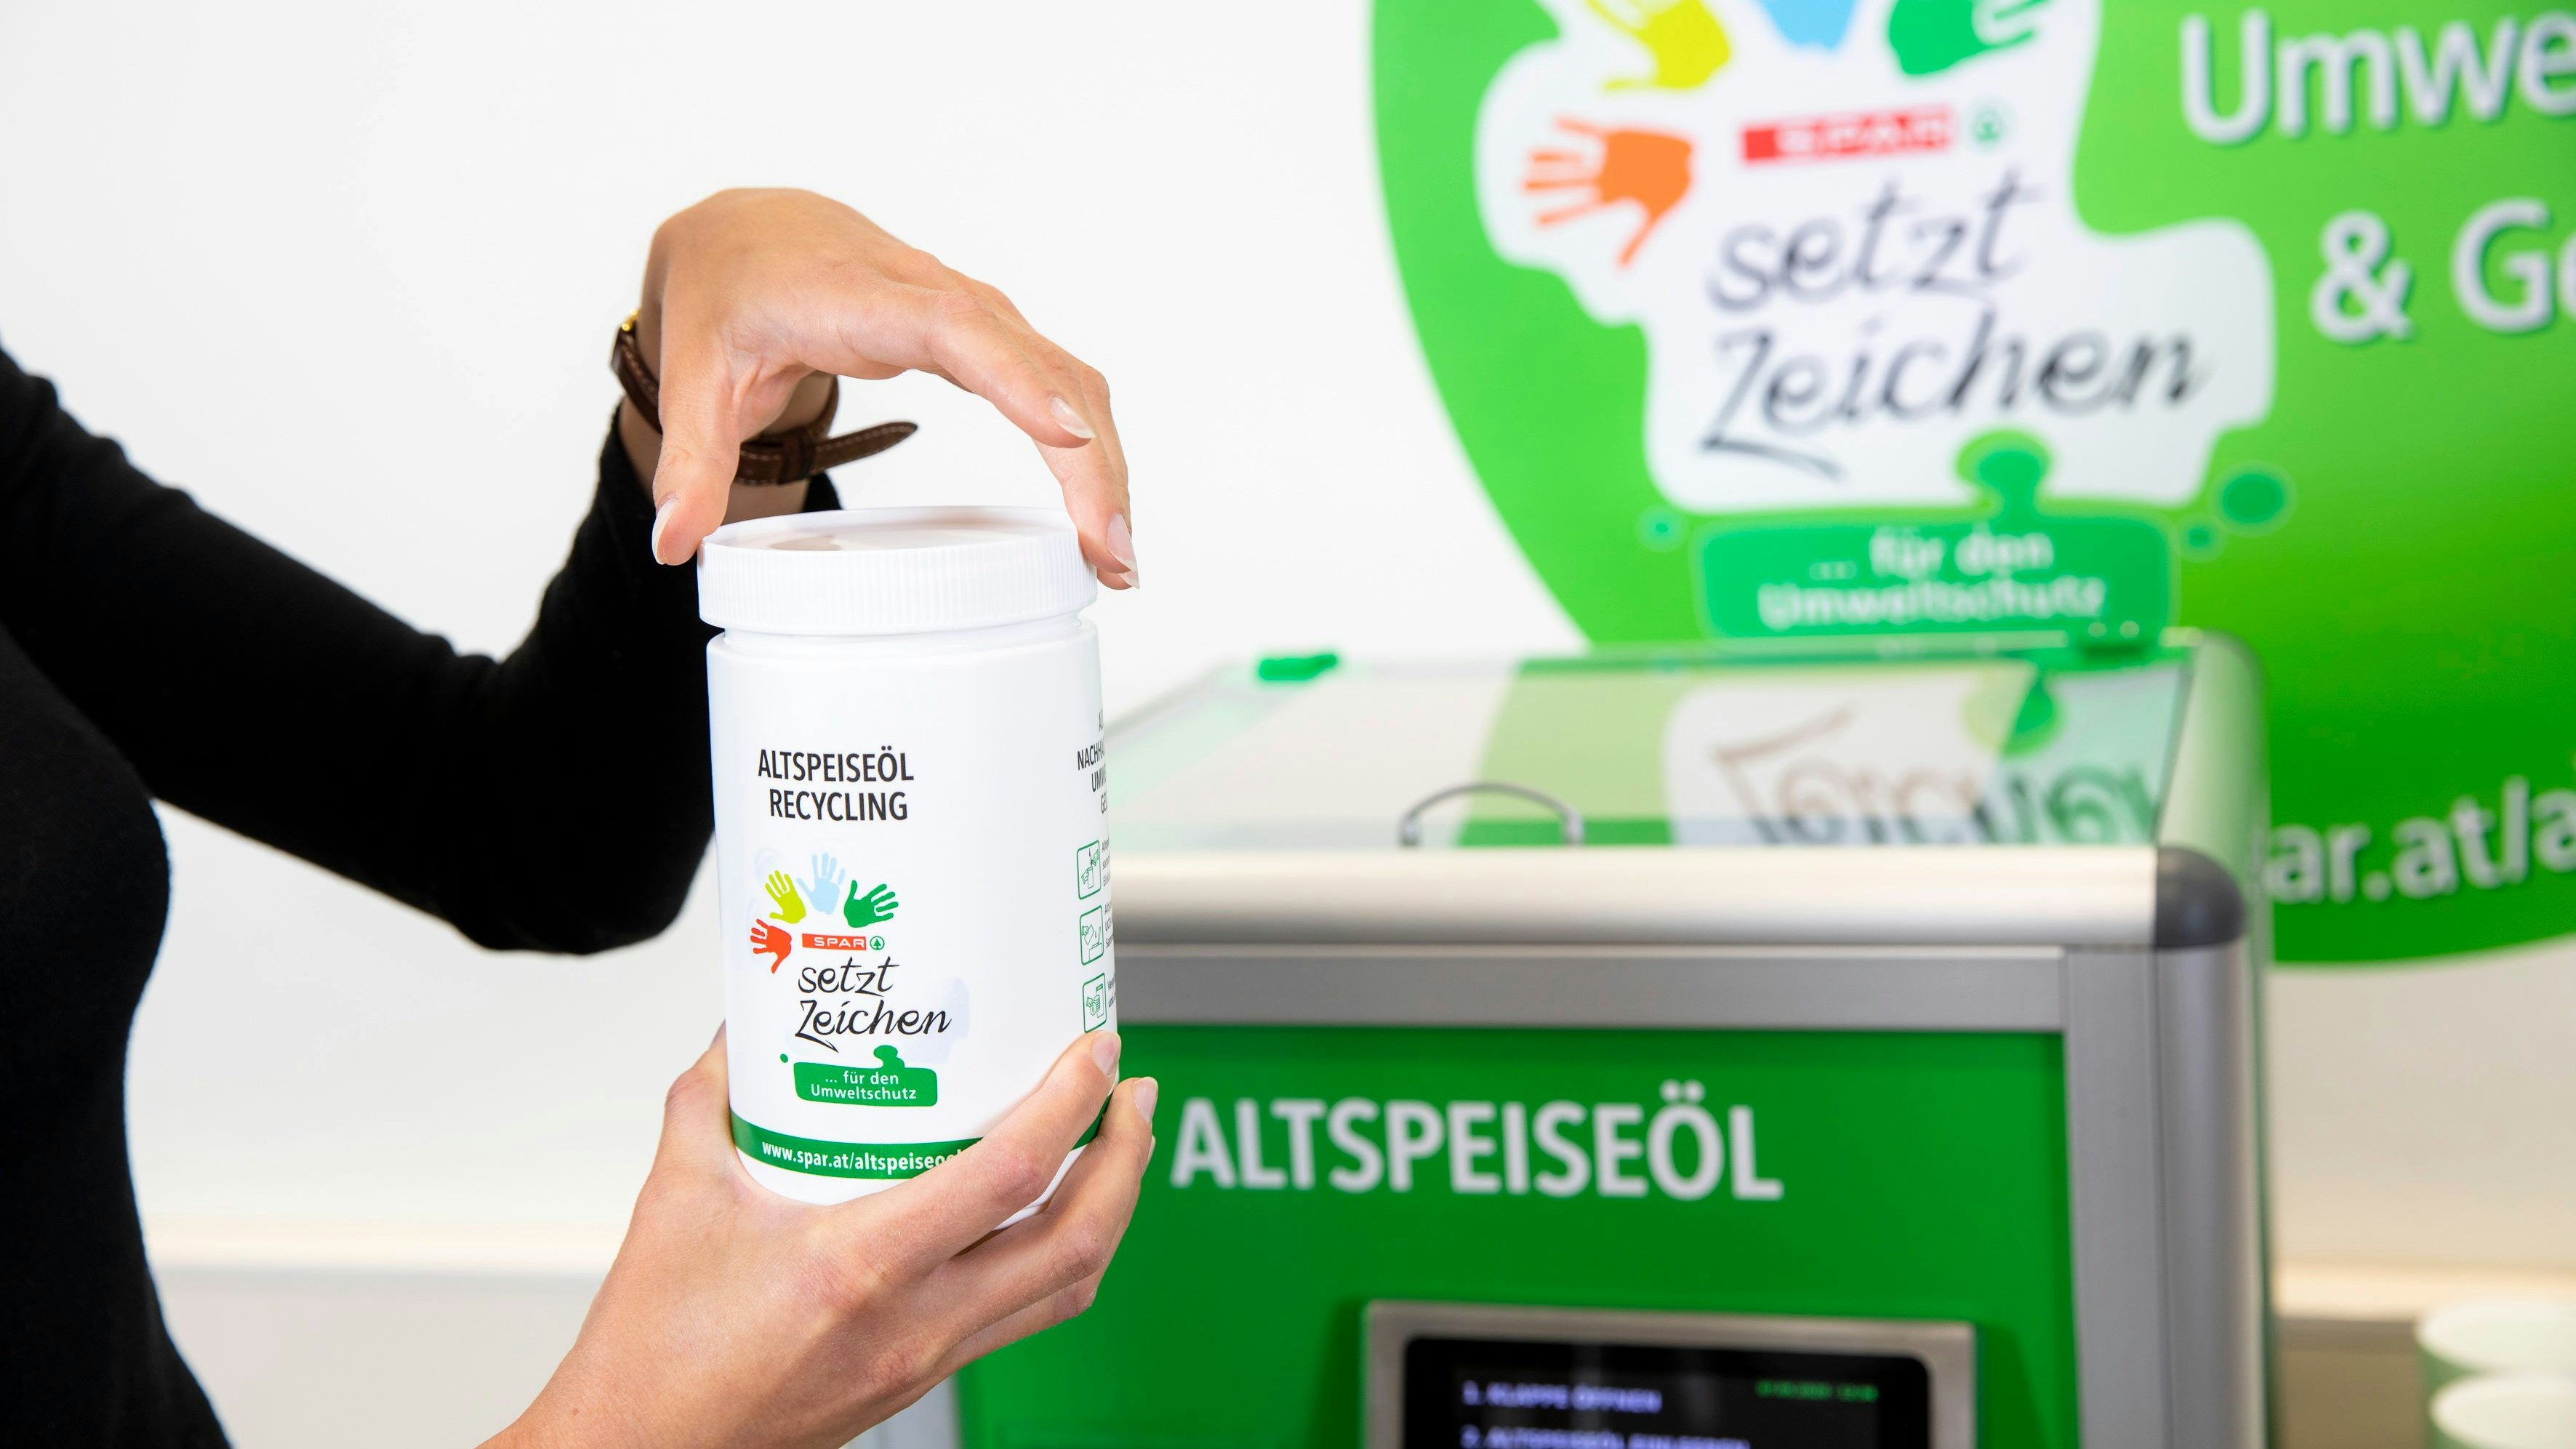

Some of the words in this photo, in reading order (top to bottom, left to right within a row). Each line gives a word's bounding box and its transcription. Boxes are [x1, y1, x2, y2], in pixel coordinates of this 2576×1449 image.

[1707, 166, 2047, 311] setzt
[2311, 209, 2414, 343] &
[1700, 300, 2212, 481] Zeichen
[1954, 521, 2055, 577] den
[758, 745, 914, 782] ALTSPEISEÖL
[769, 788, 908, 821] RECYCLING
[814, 937, 865, 948] SPAR
[798, 955, 900, 998] setzt
[795, 1000, 952, 1053] Zeichen
[811, 1084, 916, 1099] Umweltschutz
[843, 1070, 865, 1085] für
[870, 1072, 899, 1085] den
[1169, 1079, 1785, 1202] ALTSPEISEÖL
